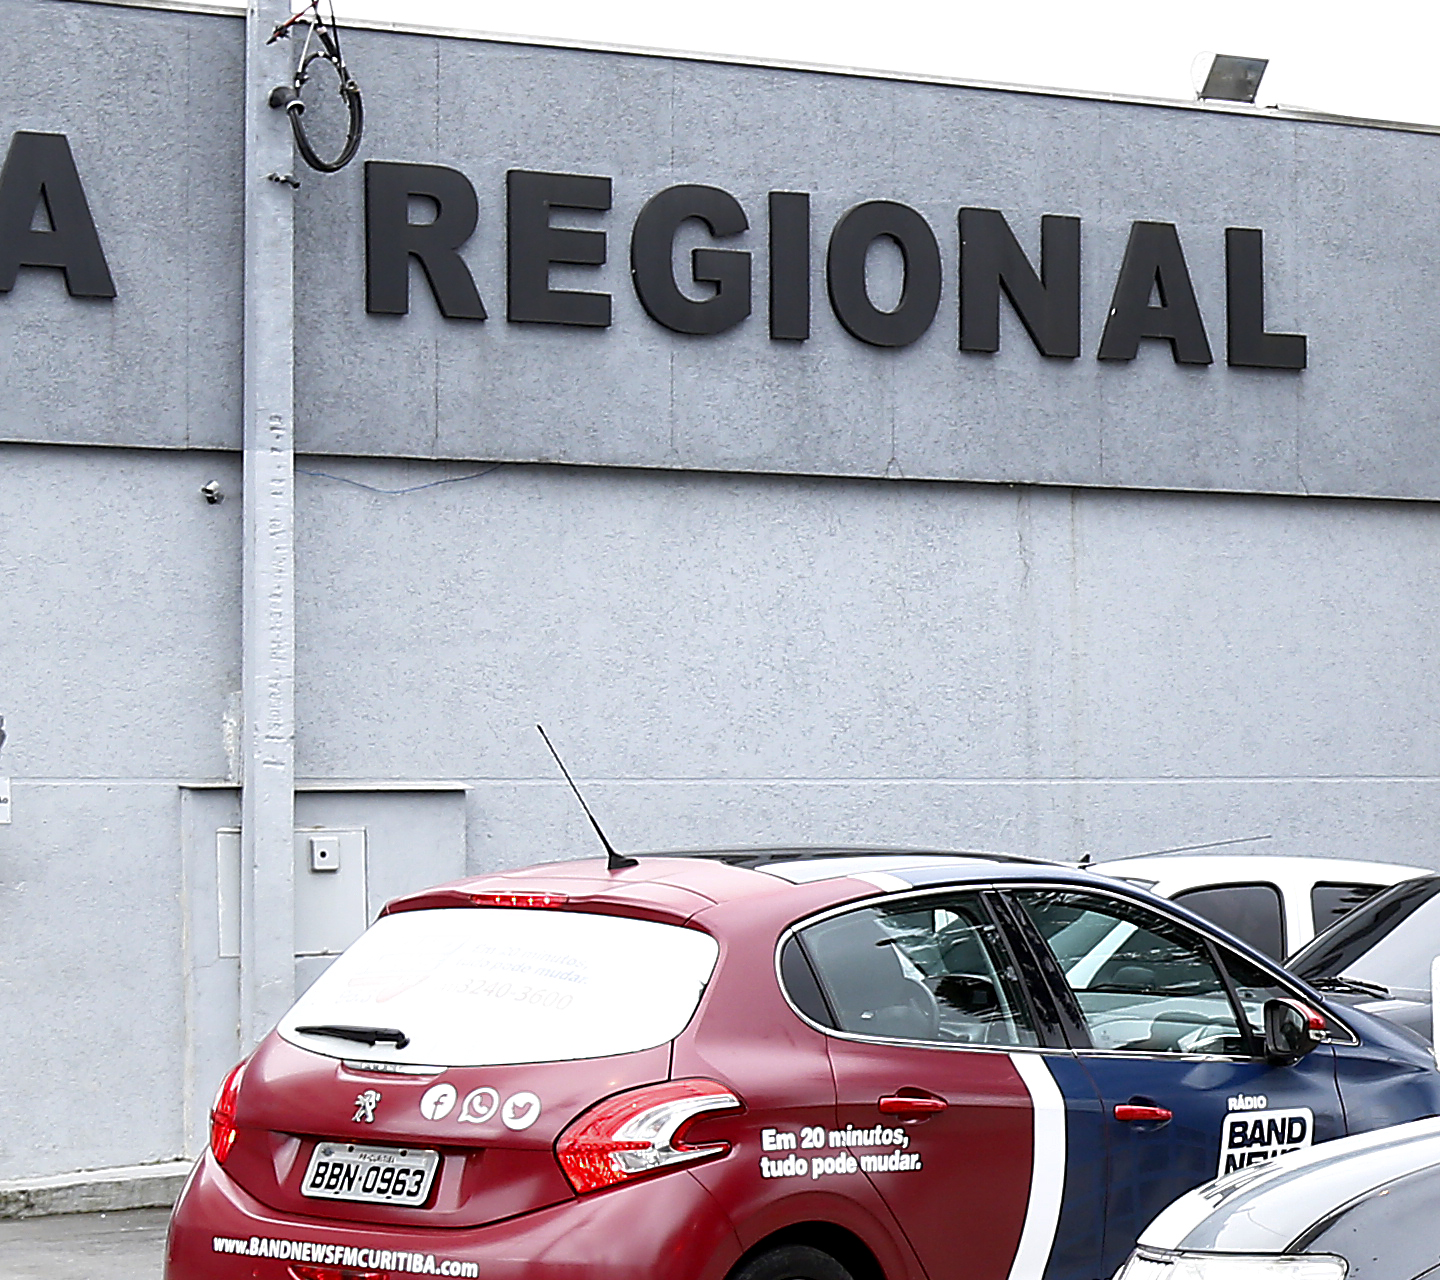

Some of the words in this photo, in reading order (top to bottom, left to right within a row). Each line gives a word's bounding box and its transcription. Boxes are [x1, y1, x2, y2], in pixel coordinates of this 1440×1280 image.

[364, 159, 1308, 369] REGIONAL
[1227, 1094, 1267, 1111] RÁDIO
[761, 1128, 797, 1152] Em
[800, 1127, 825, 1149] 20
[828, 1124, 910, 1149] minutos,
[1228, 1116, 1307, 1150] BAND
[760, 1153, 809, 1178] tudo
[812, 1151, 858, 1180] pode
[860, 1149, 922, 1172] mudar.
[213, 1236, 480, 1278] www.BANDNEWSFMCURITIBA.com
